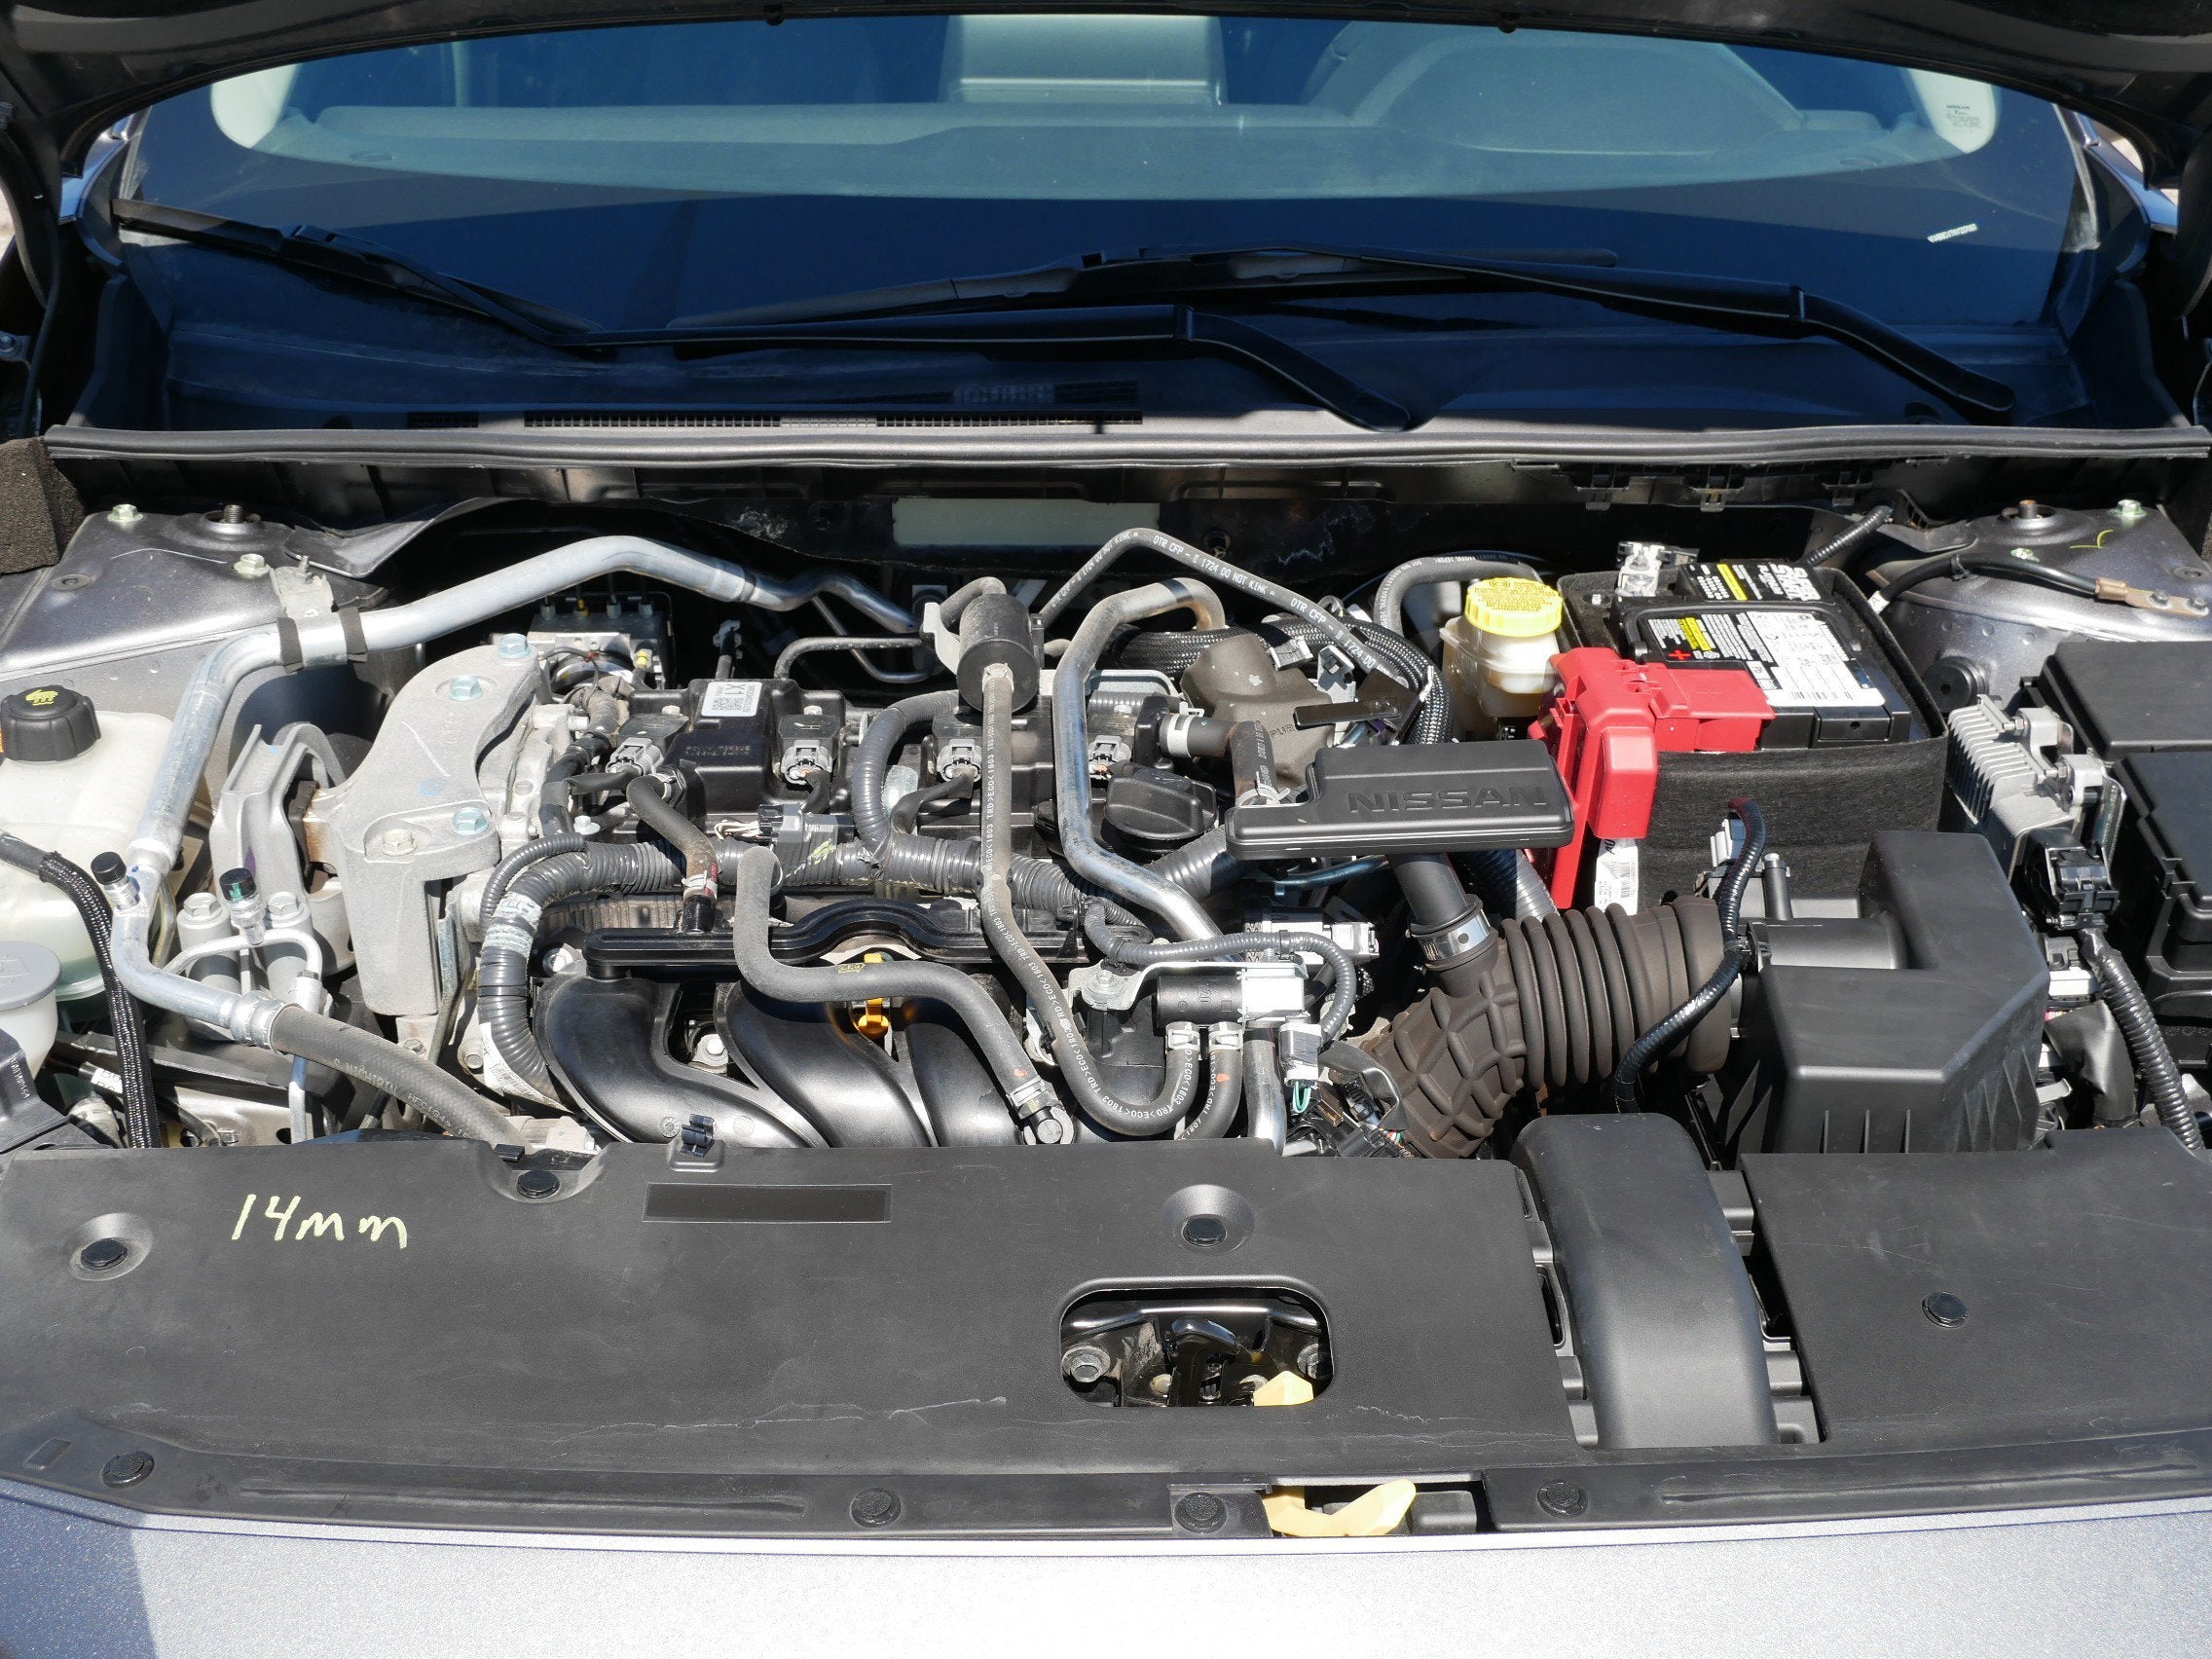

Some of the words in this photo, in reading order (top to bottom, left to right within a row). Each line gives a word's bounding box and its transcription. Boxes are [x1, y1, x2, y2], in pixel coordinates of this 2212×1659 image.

[1200, 558, 1220, 572] 1724
[1232, 571, 1248, 585] NOT
[1248, 580, 1269, 595] KINK
[1769, 562, 1803, 601] START
[1290, 597, 1309, 613] DTR
[1309, 608, 1327, 624] CFP
[1344, 639, 1364, 659] 1724
[1363, 655, 1377, 669] DO
[1347, 786, 1548, 813] NISSAN
[232, 1194, 408, 1250] 14mm
